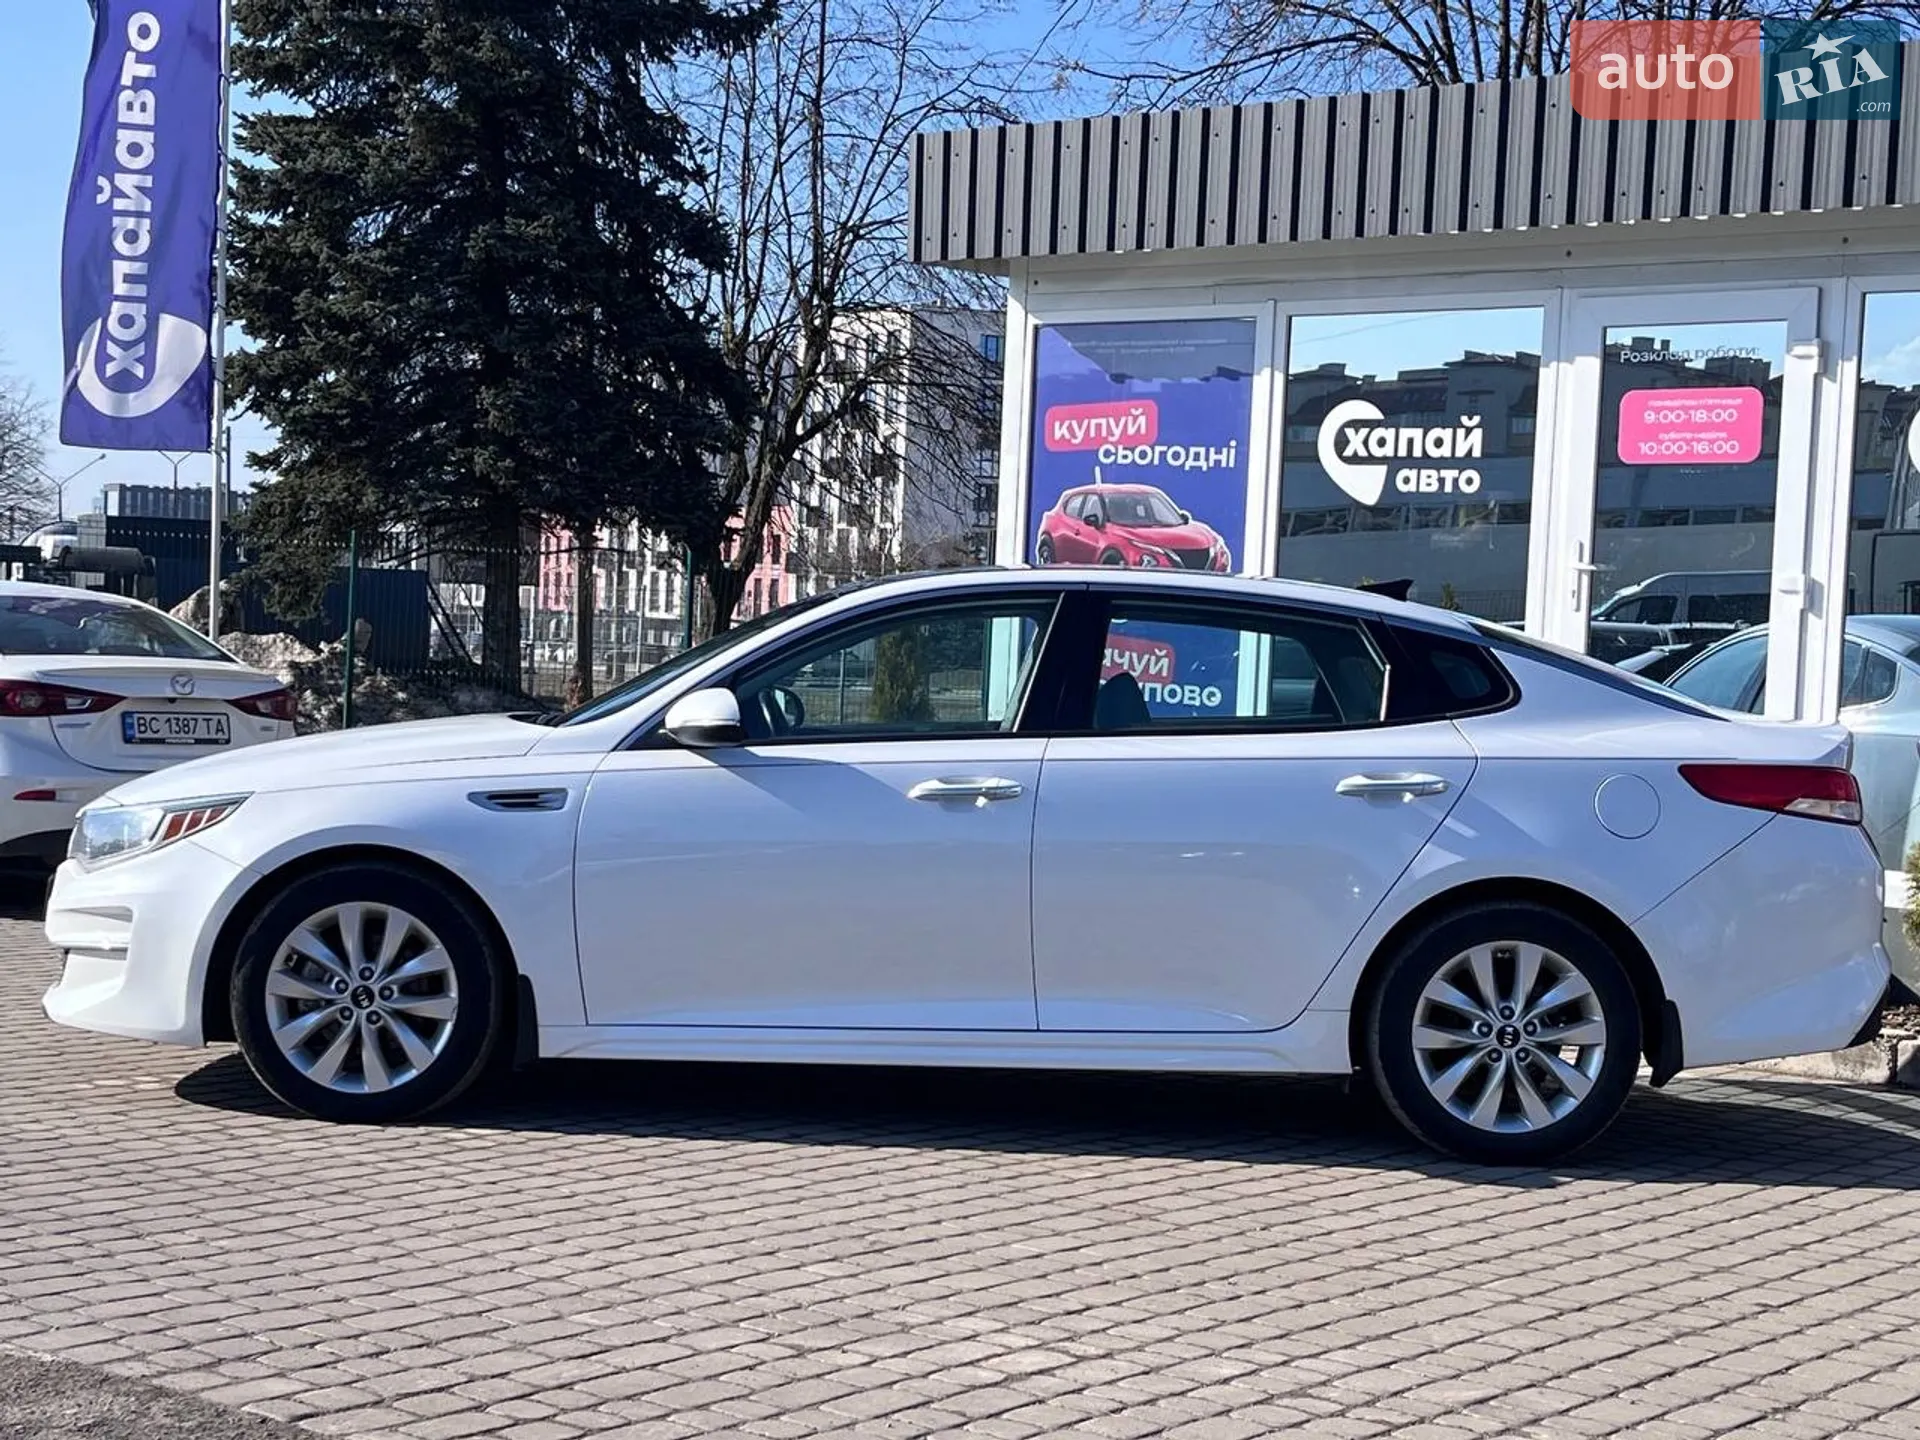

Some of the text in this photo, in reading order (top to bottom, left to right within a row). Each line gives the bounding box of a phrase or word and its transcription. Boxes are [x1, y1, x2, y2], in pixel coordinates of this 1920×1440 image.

[1053, 407, 1147, 444] купуй
[1097, 440, 1237, 472] сьогодні
[1395, 468, 1481, 494] авто
[137, 716, 226, 736] BC 1387 TA
